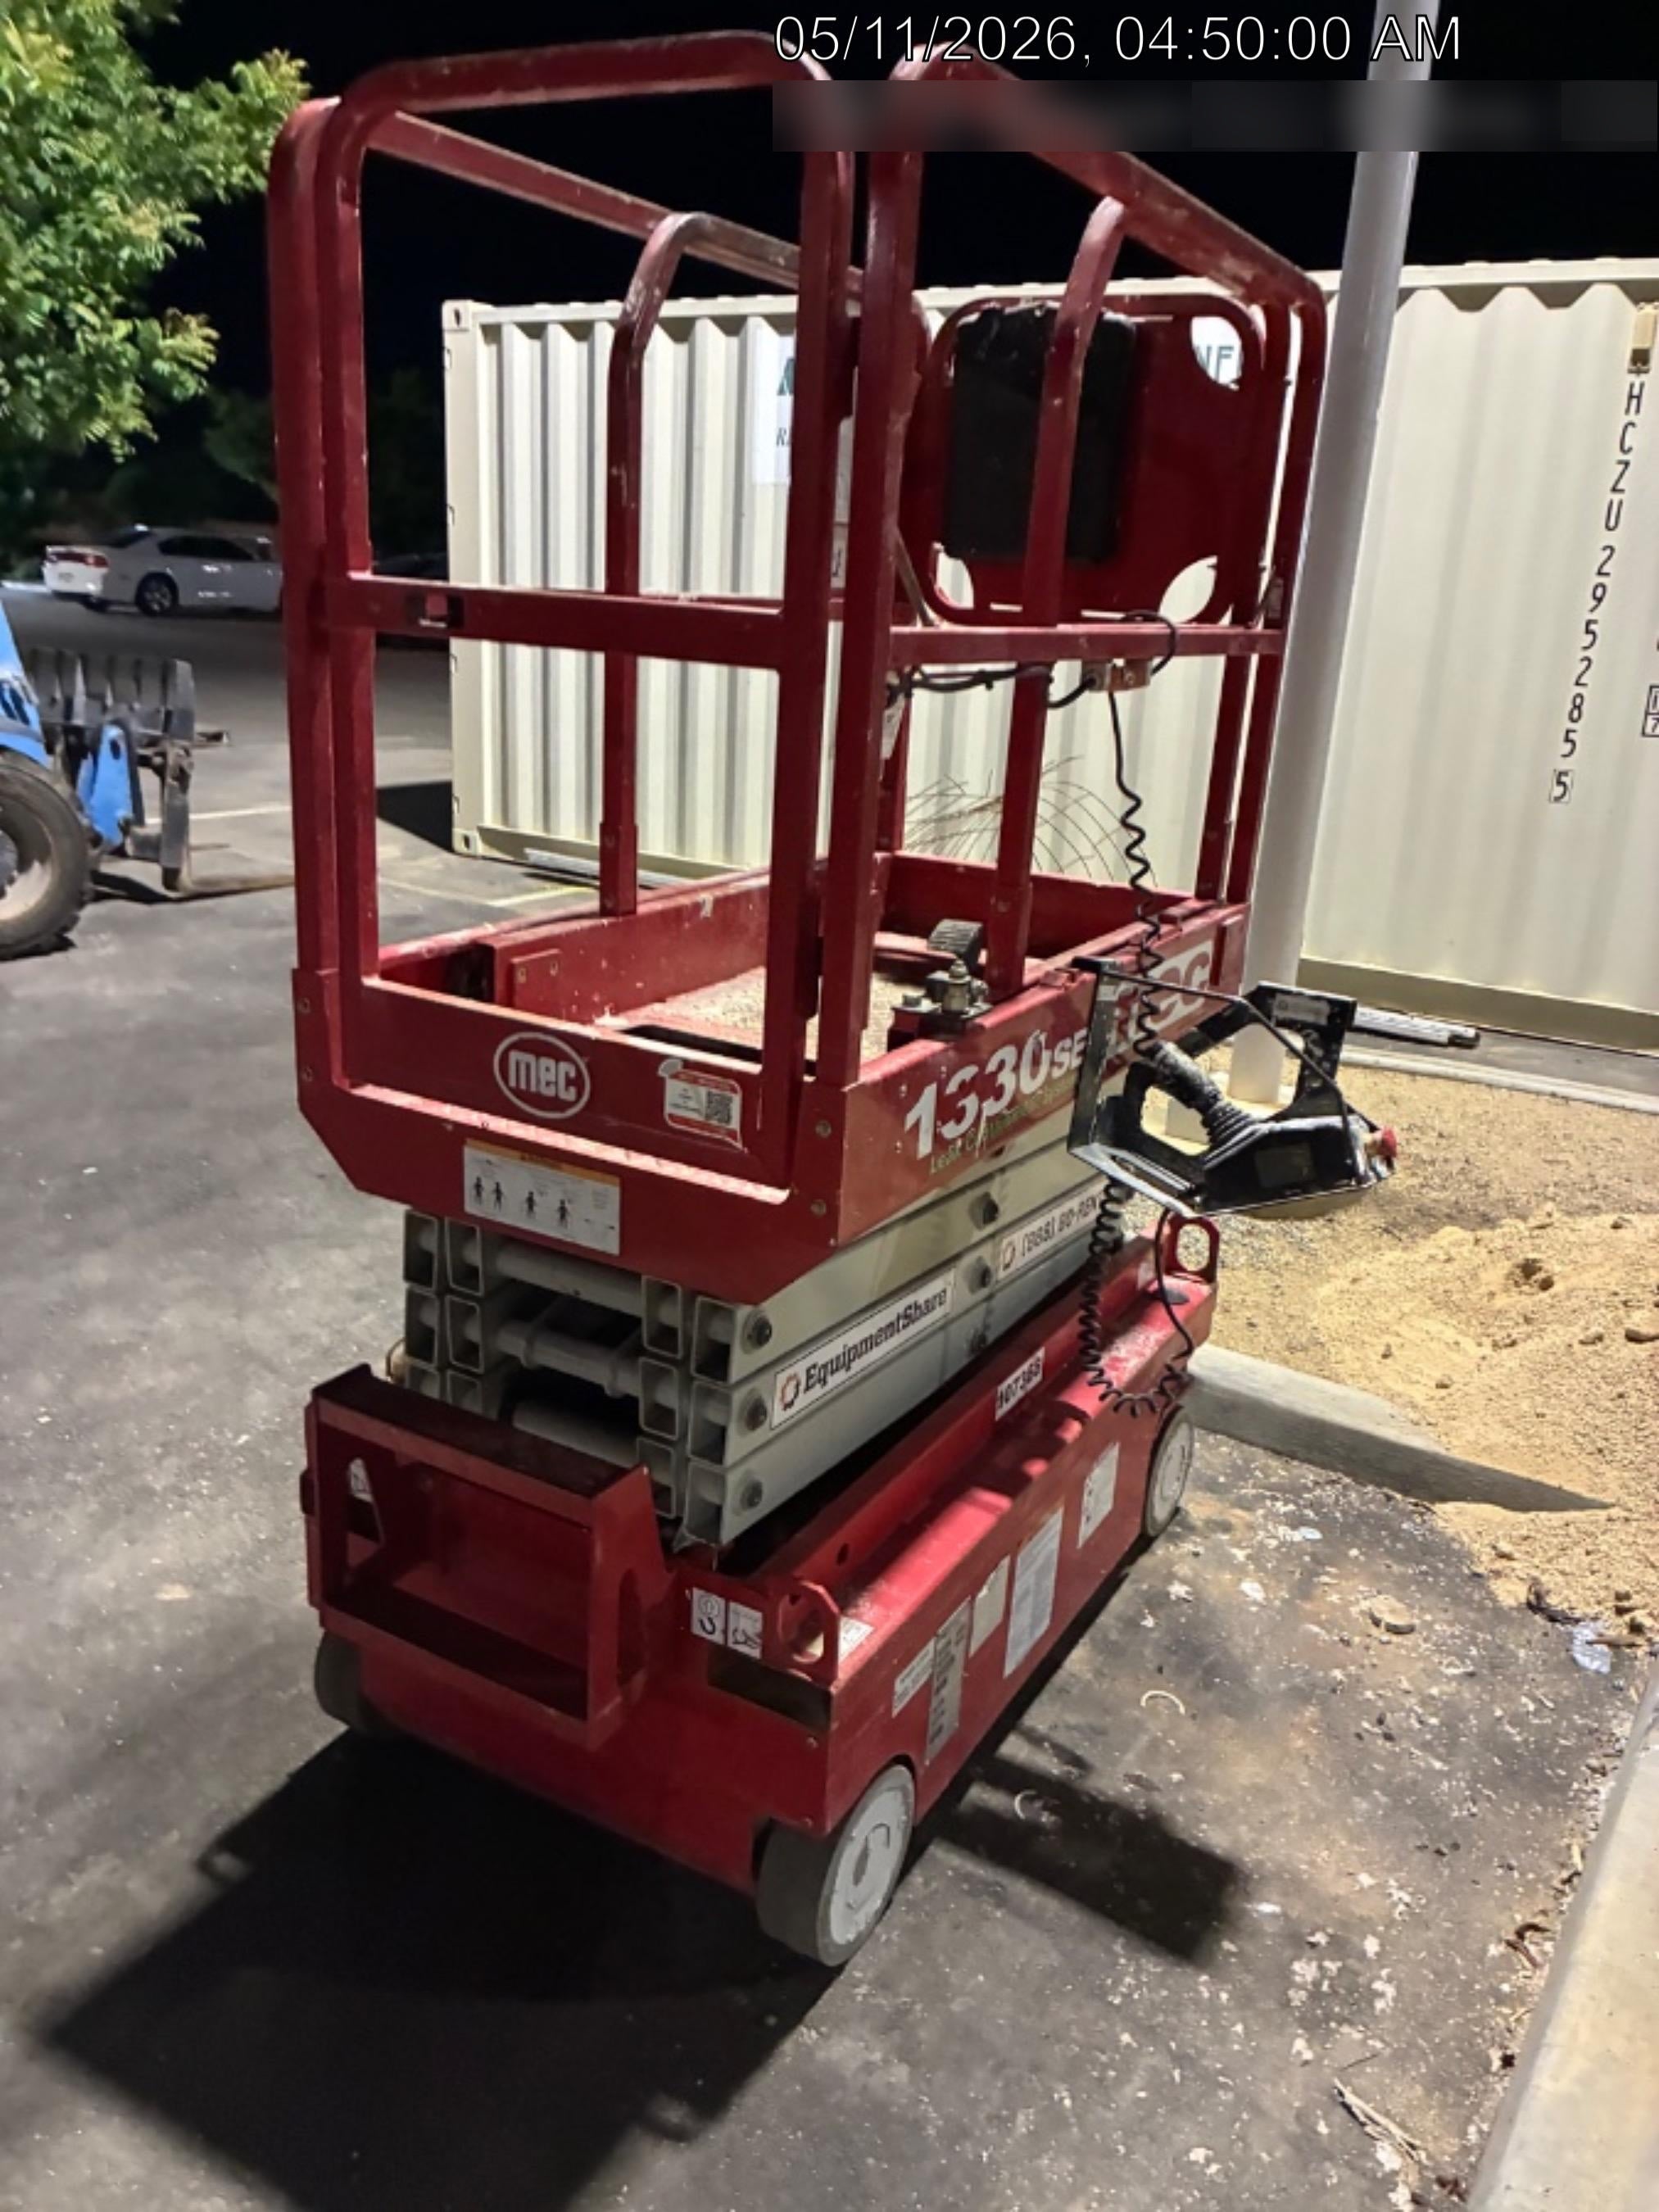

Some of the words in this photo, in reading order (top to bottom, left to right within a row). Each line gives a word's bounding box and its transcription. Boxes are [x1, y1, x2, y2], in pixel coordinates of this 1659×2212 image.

[1605, 381, 1643, 531] HCZU
[1560, 545, 1616, 758] 295285
[803, 1285, 948, 1391] EquipmentShare
